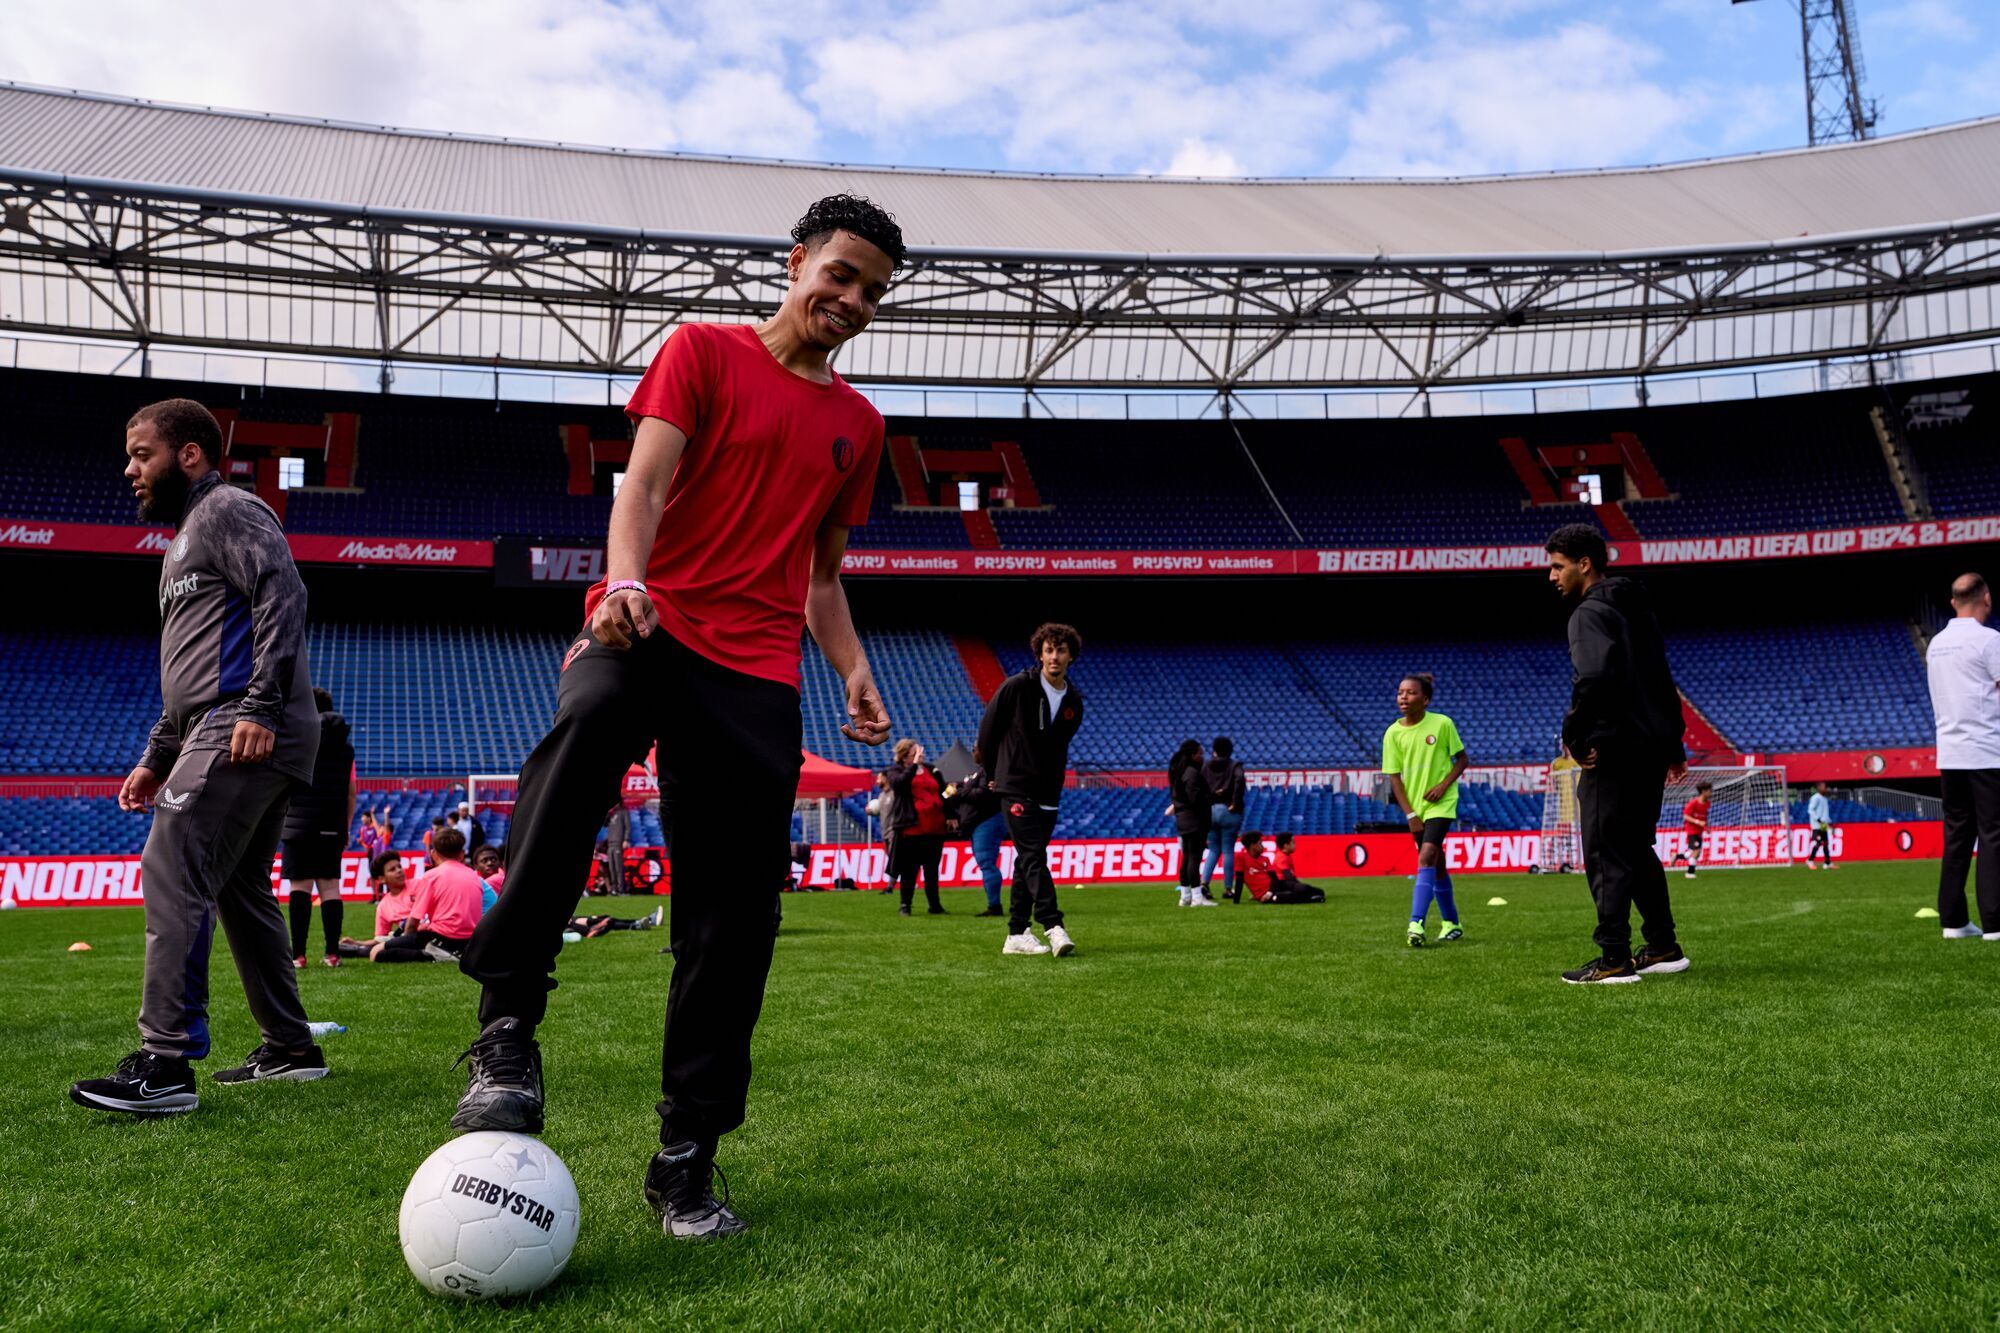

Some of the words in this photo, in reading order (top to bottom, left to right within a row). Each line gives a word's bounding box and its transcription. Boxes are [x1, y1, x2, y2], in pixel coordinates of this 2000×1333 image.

[1640, 538, 1751, 563] WINNAAR
[1753, 533, 1809, 558] UEFA
[1812, 530, 1856, 553] CUP
[1859, 524, 1916, 549] 1974
[1919, 523, 1944, 545] &
[1947, 518, 2000, 543] 200
[530, 547, 607, 581] WEL
[890, 556, 959, 569] vakanties
[1051, 557, 1118, 570] vakanties
[1208, 556, 1274, 569] vakanties
[1317, 550, 1341, 572] 16
[1341, 549, 1397, 571] KEER
[1398, 546, 1551, 570] LANDSKAMPIO
[1442, 835, 1584, 869] EYENO
[0, 861, 143, 901] NOORD
[451, 1173, 555, 1233] DERBYSTAR
